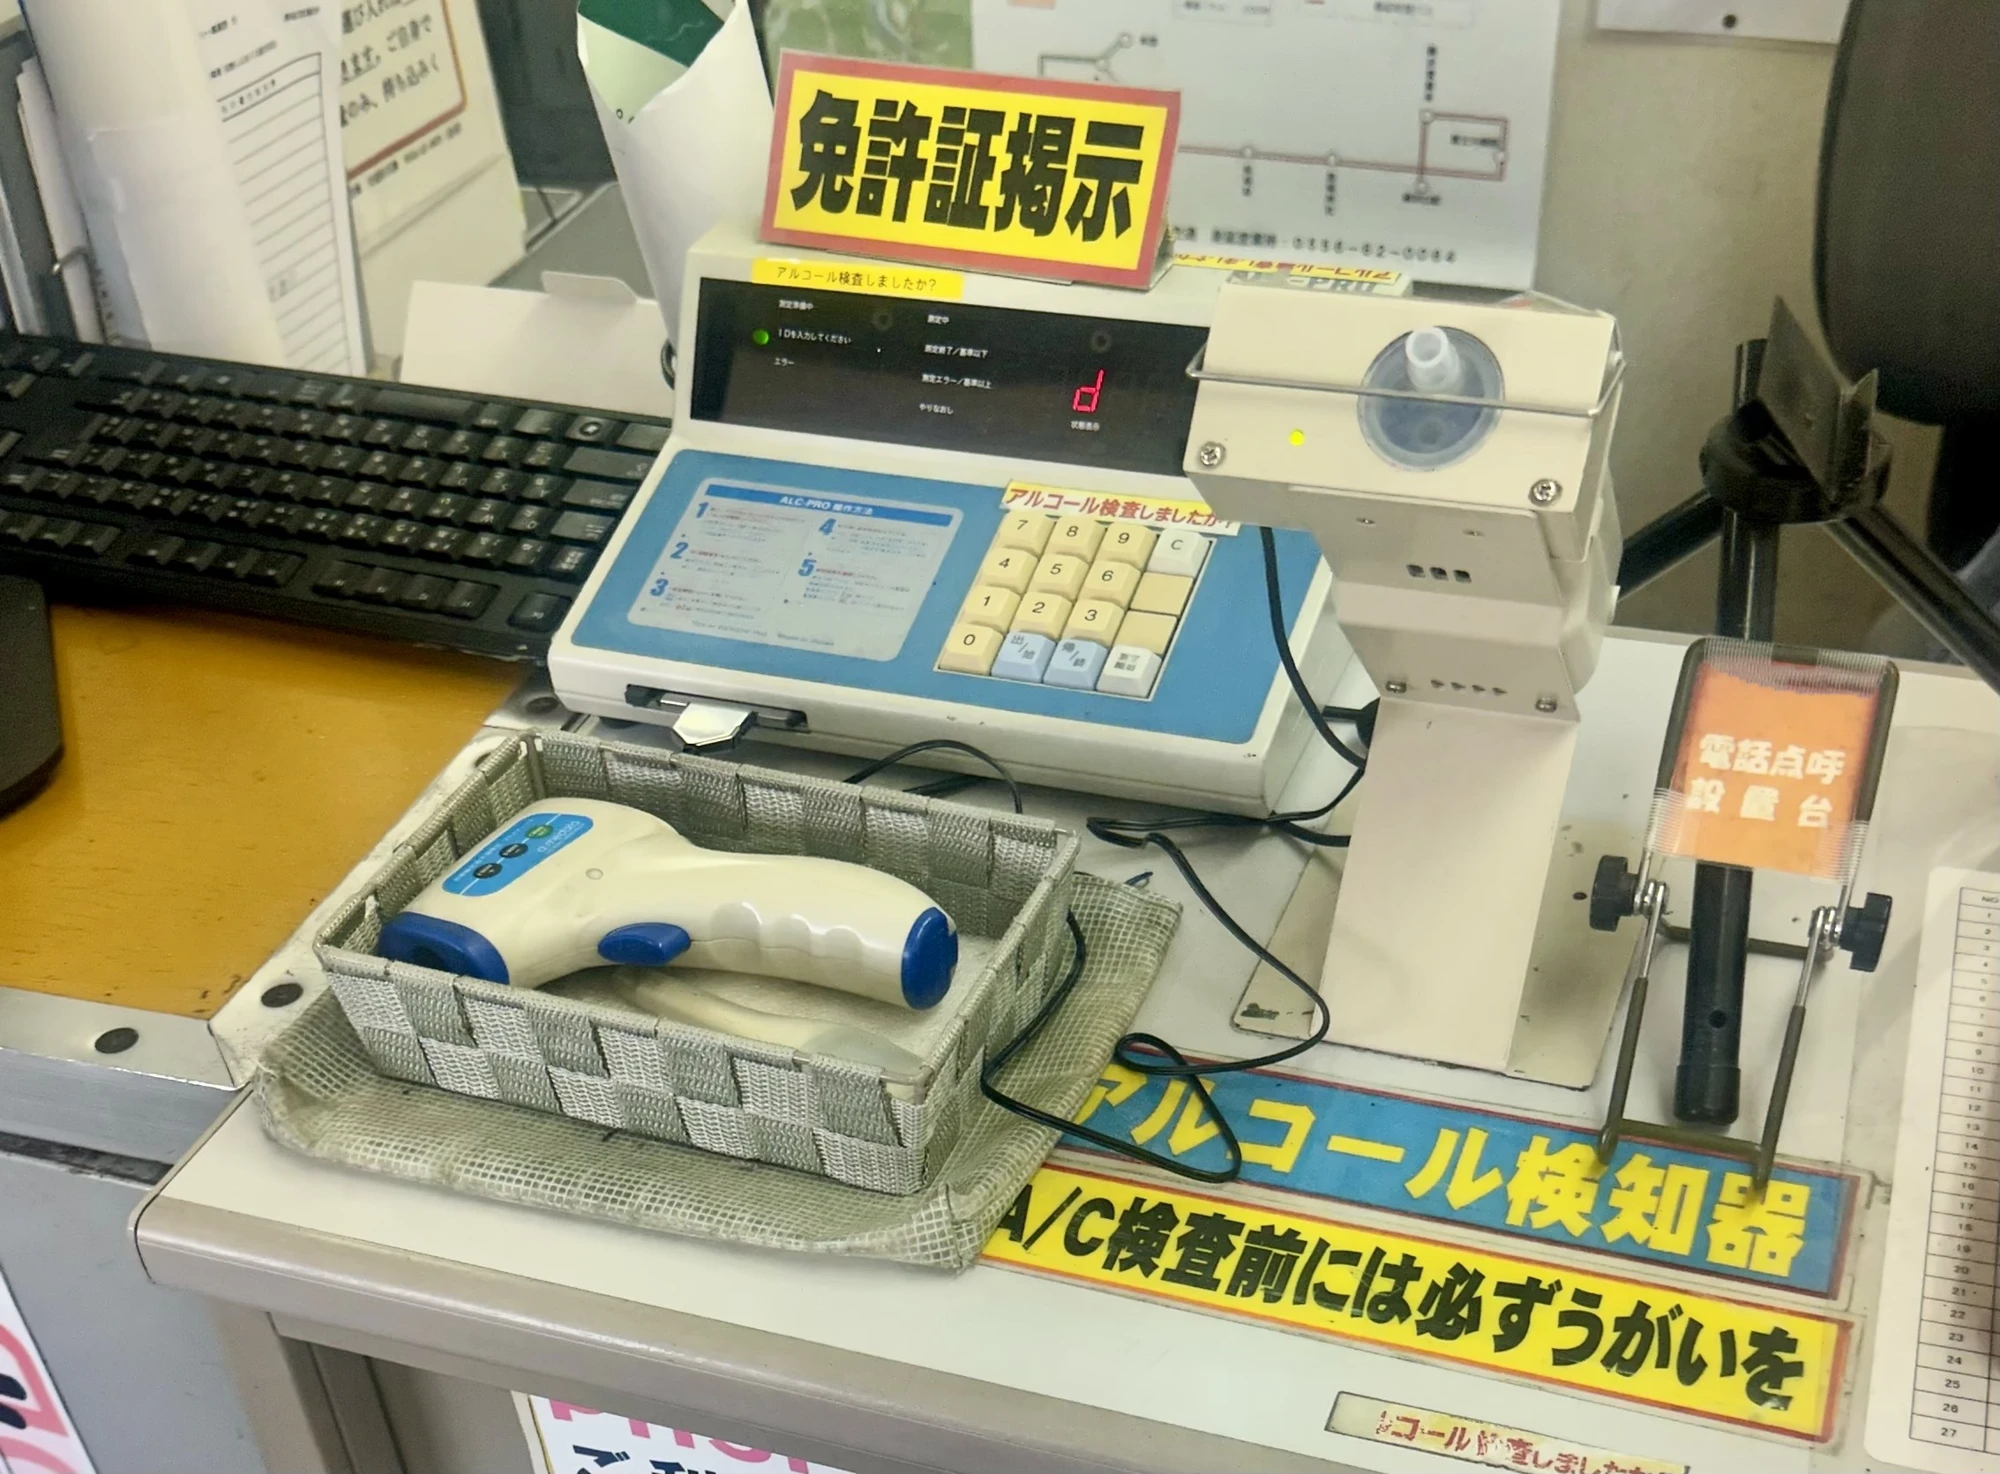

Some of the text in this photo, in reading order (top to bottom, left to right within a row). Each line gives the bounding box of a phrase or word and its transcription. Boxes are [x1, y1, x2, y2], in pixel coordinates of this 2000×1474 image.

[790, 90, 1145, 242] 免許証掲示
[776, 266, 937, 291] アルコール検査しましたか?
[778, 328, 853, 345] IDを入力してください
[774, 356, 795, 367] エラー
[919, 403, 954, 416] やりなおし
[696, 502, 709, 519] 1
[1006, 488, 1232, 530] アルコール検査しましたか
[818, 518, 837, 536] 4
[1017, 520, 1028, 530] 7
[1066, 526, 1079, 537] 8
[1118, 532, 1130, 544] 9
[1170, 539, 1183, 550] C
[670, 541, 689, 560] 2
[797, 558, 817, 577] 5
[999, 557, 1010, 569] 4
[1050, 563, 1062, 575] 5
[1101, 570, 1114, 582] 6
[650, 578, 669, 597] 3
[983, 596, 991, 607] 1
[1032, 601, 1045, 614] 2
[1084, 609, 1097, 621] 3
[963, 634, 976, 647] 0
[1699, 733, 1846, 785] 電話点呼
[1984, 927, 1991, 935] 2
[1982, 960, 1989, 968] 4
[1975, 1048, 1982, 1056] 9
[1971, 1066, 1984, 1075] 10
[1970, 1085, 1982, 1094] 11
[1968, 1104, 1981, 1112] 12
[1966, 1123, 1980, 1131] 13
[1965, 1142, 1979, 1151] 14
[1073, 1063, 1811, 1278] アルコール検知器
[1963, 1162, 1976, 1171] 15
[1962, 1182, 1975, 1191] 16
[1959, 1201, 1974, 1210] 17
[1958, 1223, 1972, 1232] 18
[1956, 1244, 1971, 1253] 19
[1954, 1265, 1969, 1275] 20
[996, 1183, 1805, 1411] A/C検査前には必ずうがいを
[1951, 1287, 1966, 1296] 21
[1949, 1309, 1966, 1319] 22
[1948, 1332, 1964, 1342] 23
[1946, 1355, 1962, 1366] 24
[1944, 1379, 1961, 1390] 25
[1942, 1403, 1959, 1414] 26
[1940, 1427, 1957, 1438] 27
